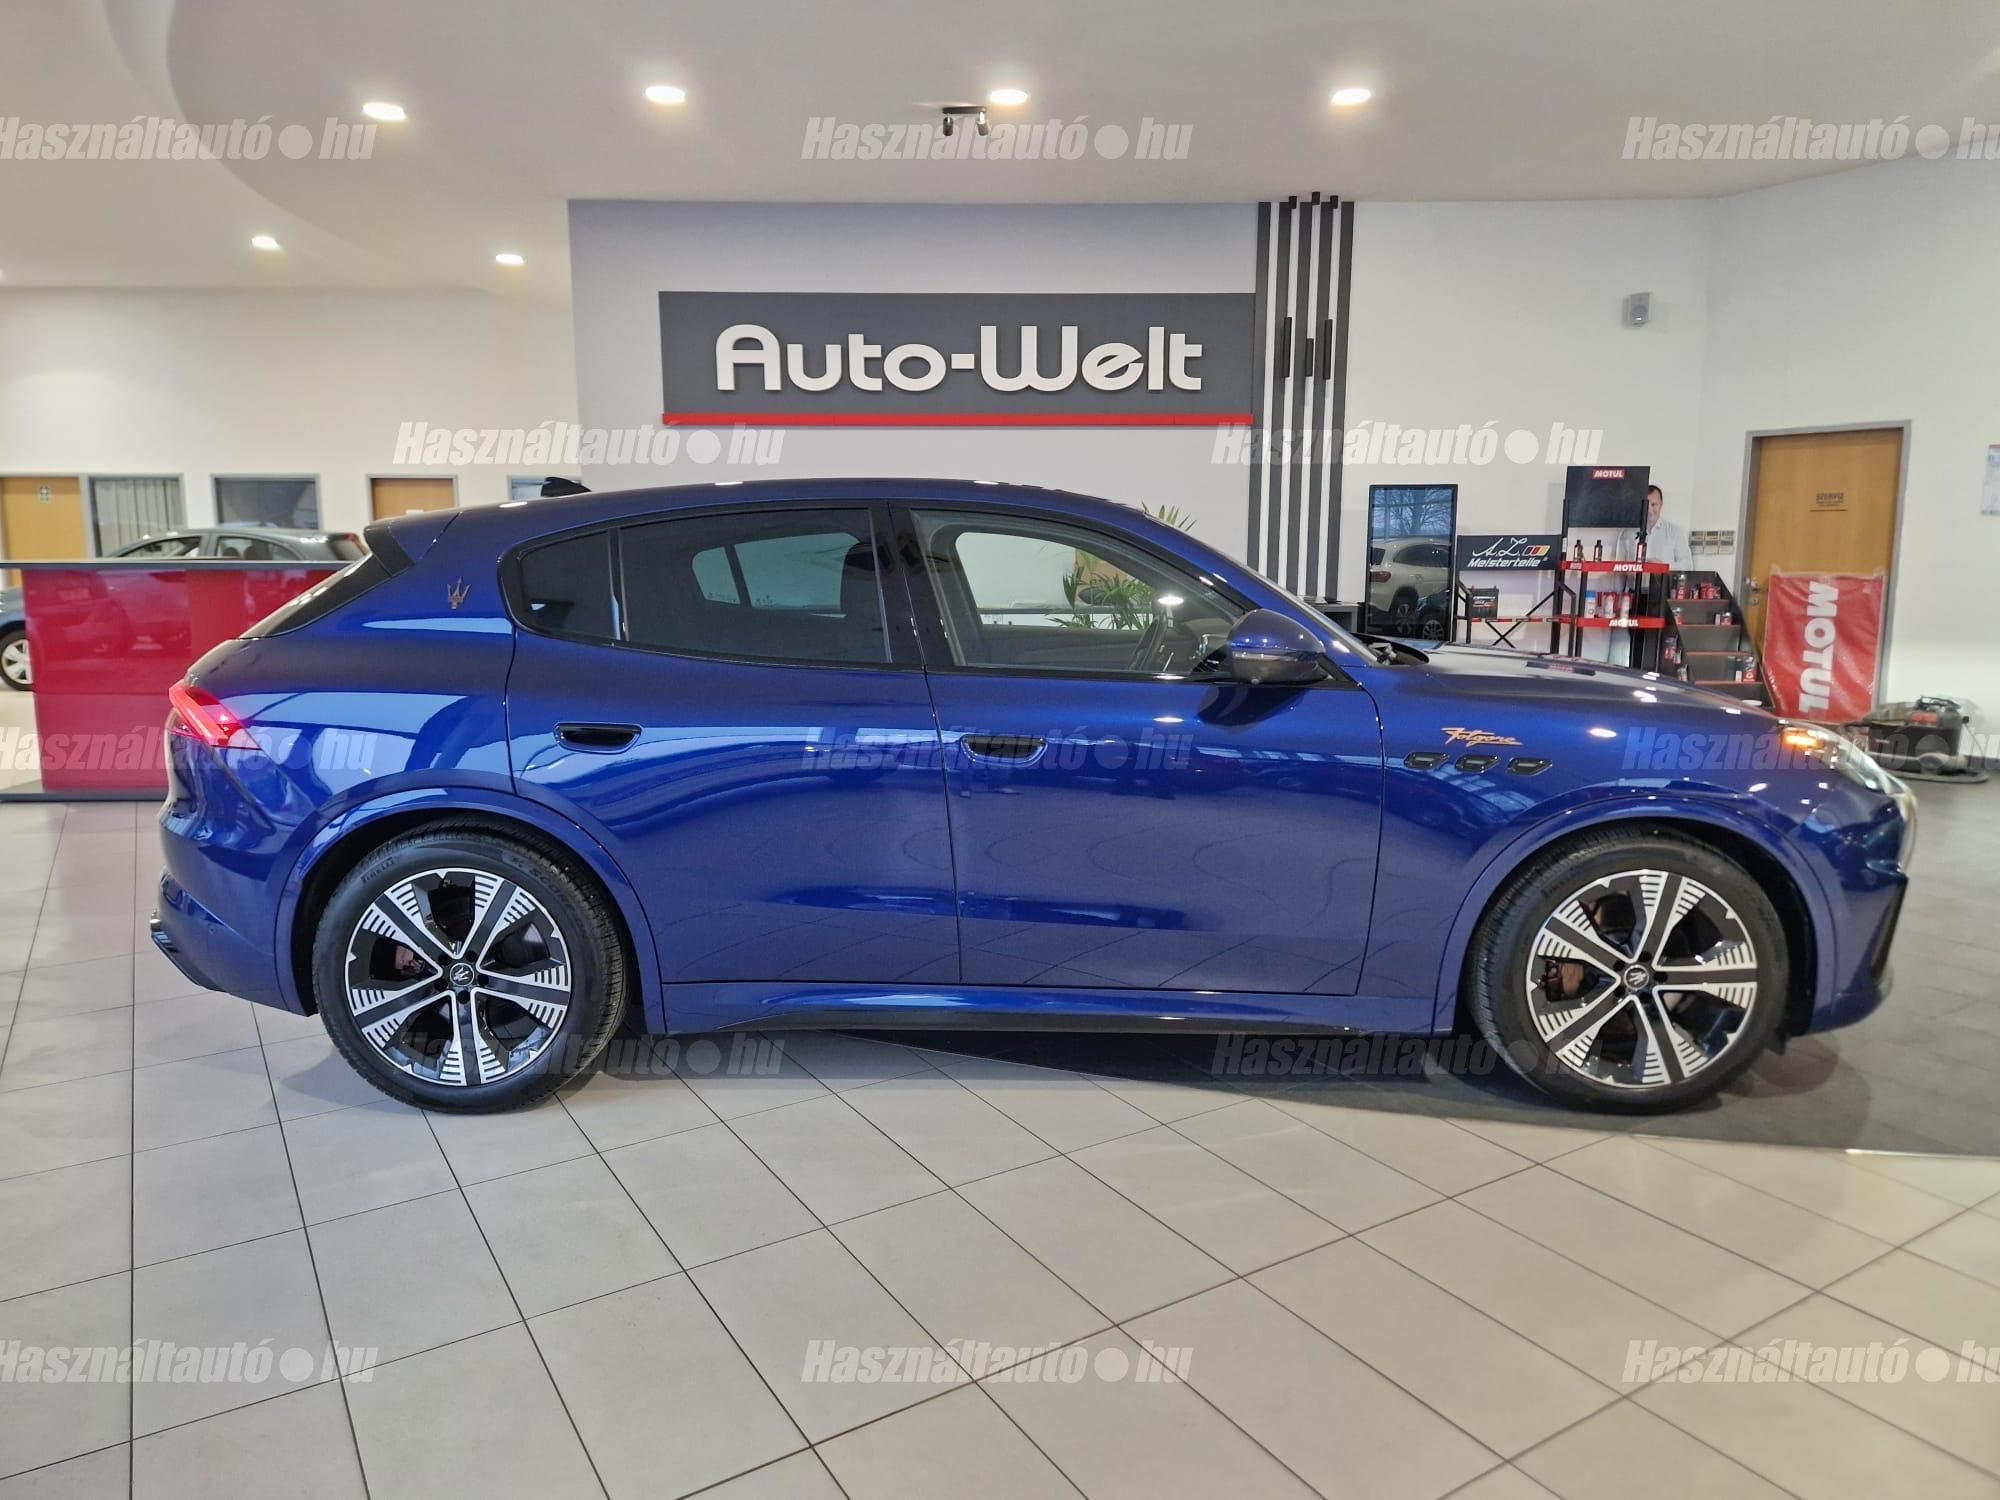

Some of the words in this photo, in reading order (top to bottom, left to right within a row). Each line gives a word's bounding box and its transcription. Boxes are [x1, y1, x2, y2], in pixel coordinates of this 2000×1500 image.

[715, 324, 1203, 391] Auto-Welt
[1593, 469, 1625, 478] MOTUL
[1467, 558, 1541, 568] Meisterteile
[1613, 563, 1644, 572] MOTUL
[1608, 618, 1639, 628] MOTUL
[1798, 580, 1840, 713] MOTUL
